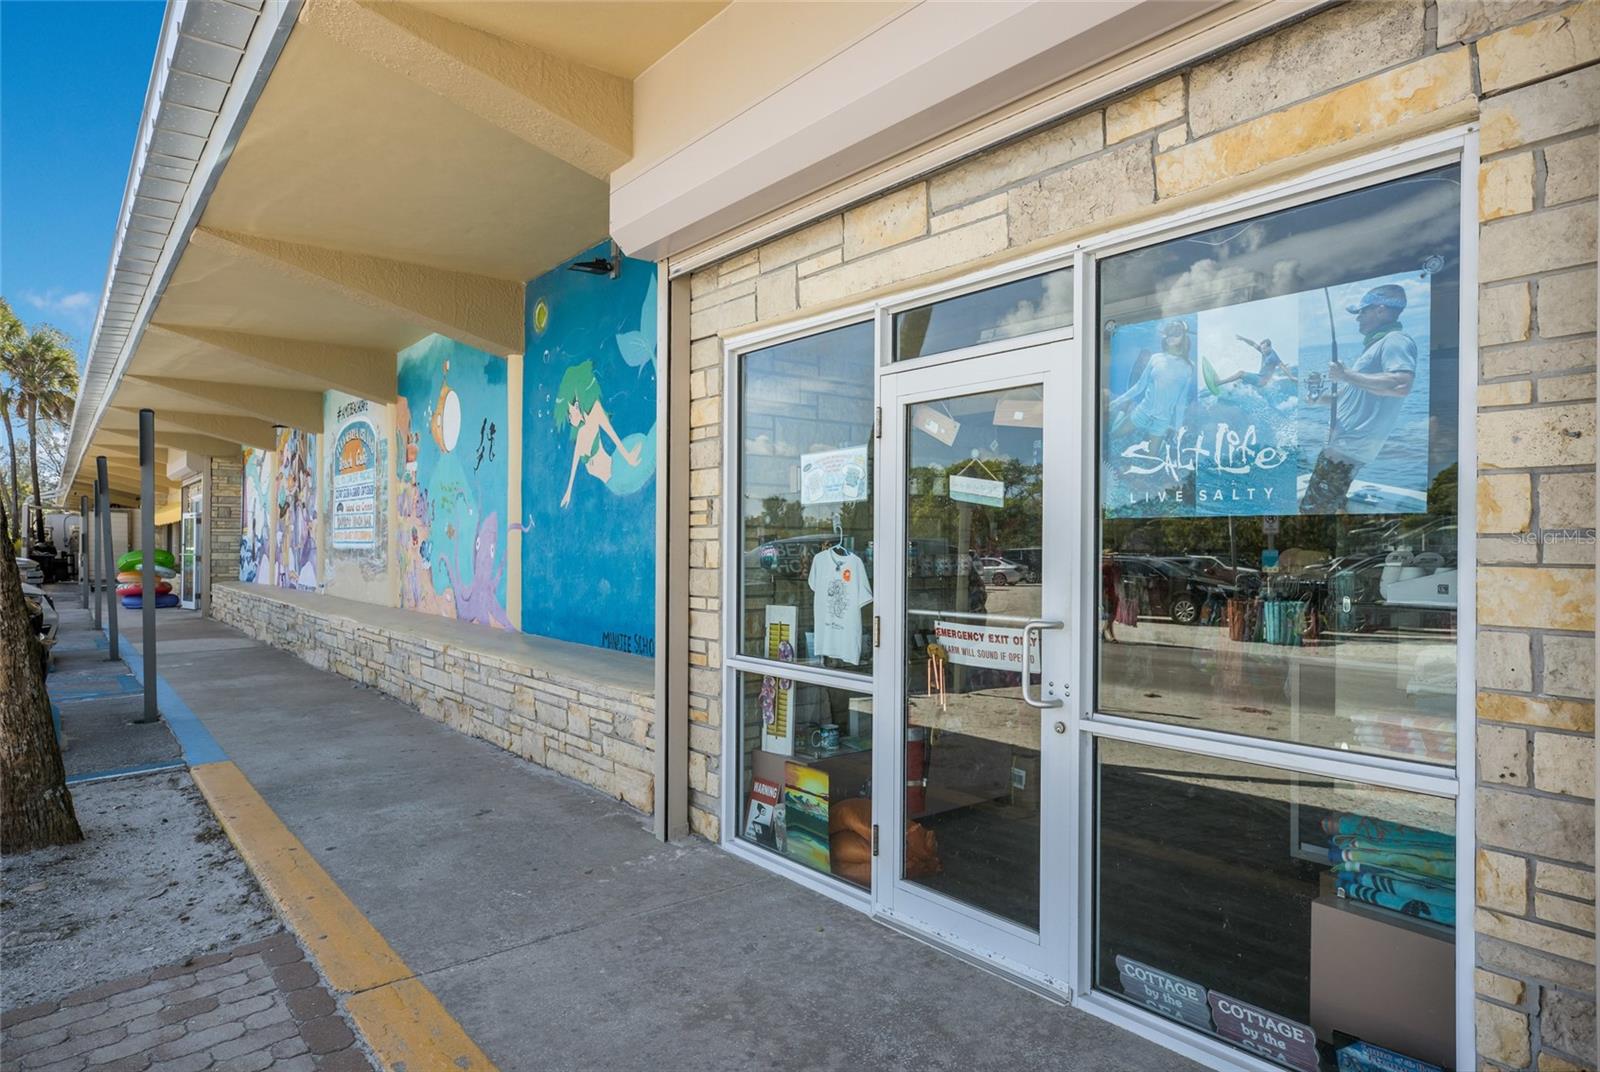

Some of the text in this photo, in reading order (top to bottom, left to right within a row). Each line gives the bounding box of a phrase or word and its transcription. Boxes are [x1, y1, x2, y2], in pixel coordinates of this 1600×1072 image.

[1130, 487, 1275, 504] LIVE SALTY
[935, 627, 1038, 648] EMERGENCY EXIT OY
[961, 647, 975, 657] WILL
[977, 650, 999, 661] SOUND
[1000, 652, 1007, 661] IF
[1008, 652, 1035, 665] OPED
[753, 782, 778, 799] WARNING
[1124, 962, 1199, 1001] COTTAGE
[1144, 984, 1183, 1008] by the
[1217, 999, 1306, 1043] COTTAGE
[1240, 1022, 1259, 1040] by
[1263, 1032, 1287, 1050] the
